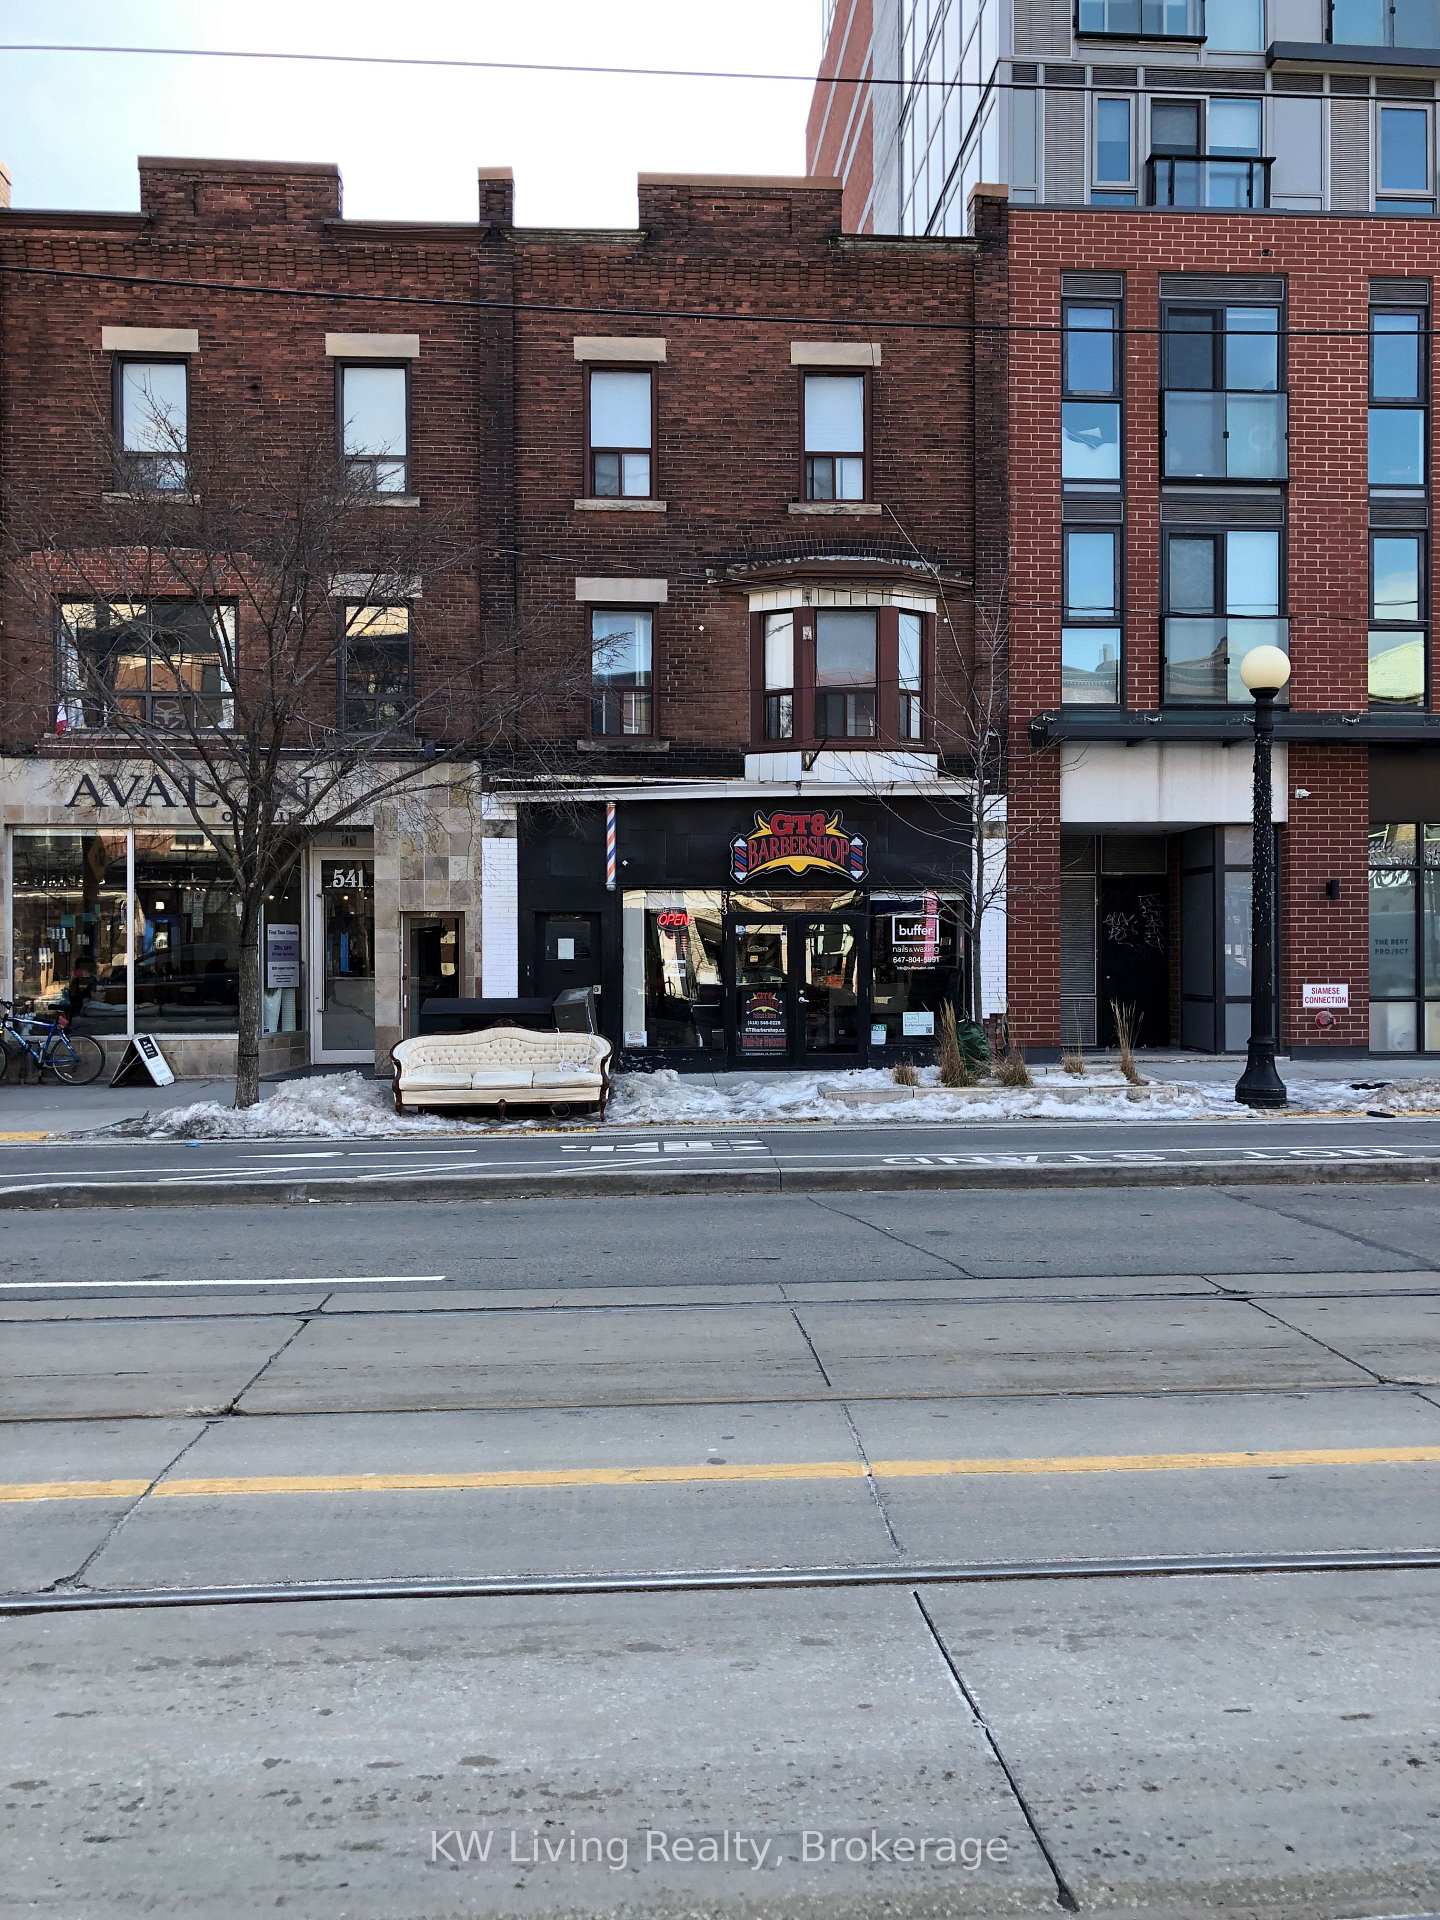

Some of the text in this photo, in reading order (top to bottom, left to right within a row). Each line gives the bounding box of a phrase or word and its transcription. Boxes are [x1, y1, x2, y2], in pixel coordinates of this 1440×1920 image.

[770, 813, 827, 836] GT8
[748, 836, 850, 869] BARBERSHOP
[333, 868, 364, 888] 541
[659, 912, 690, 926] OPEN
[899, 924, 935, 936] buffer
[1311, 987, 1341, 995] SIAMESE
[1305, 996, 1347, 1004] CONNECTION
